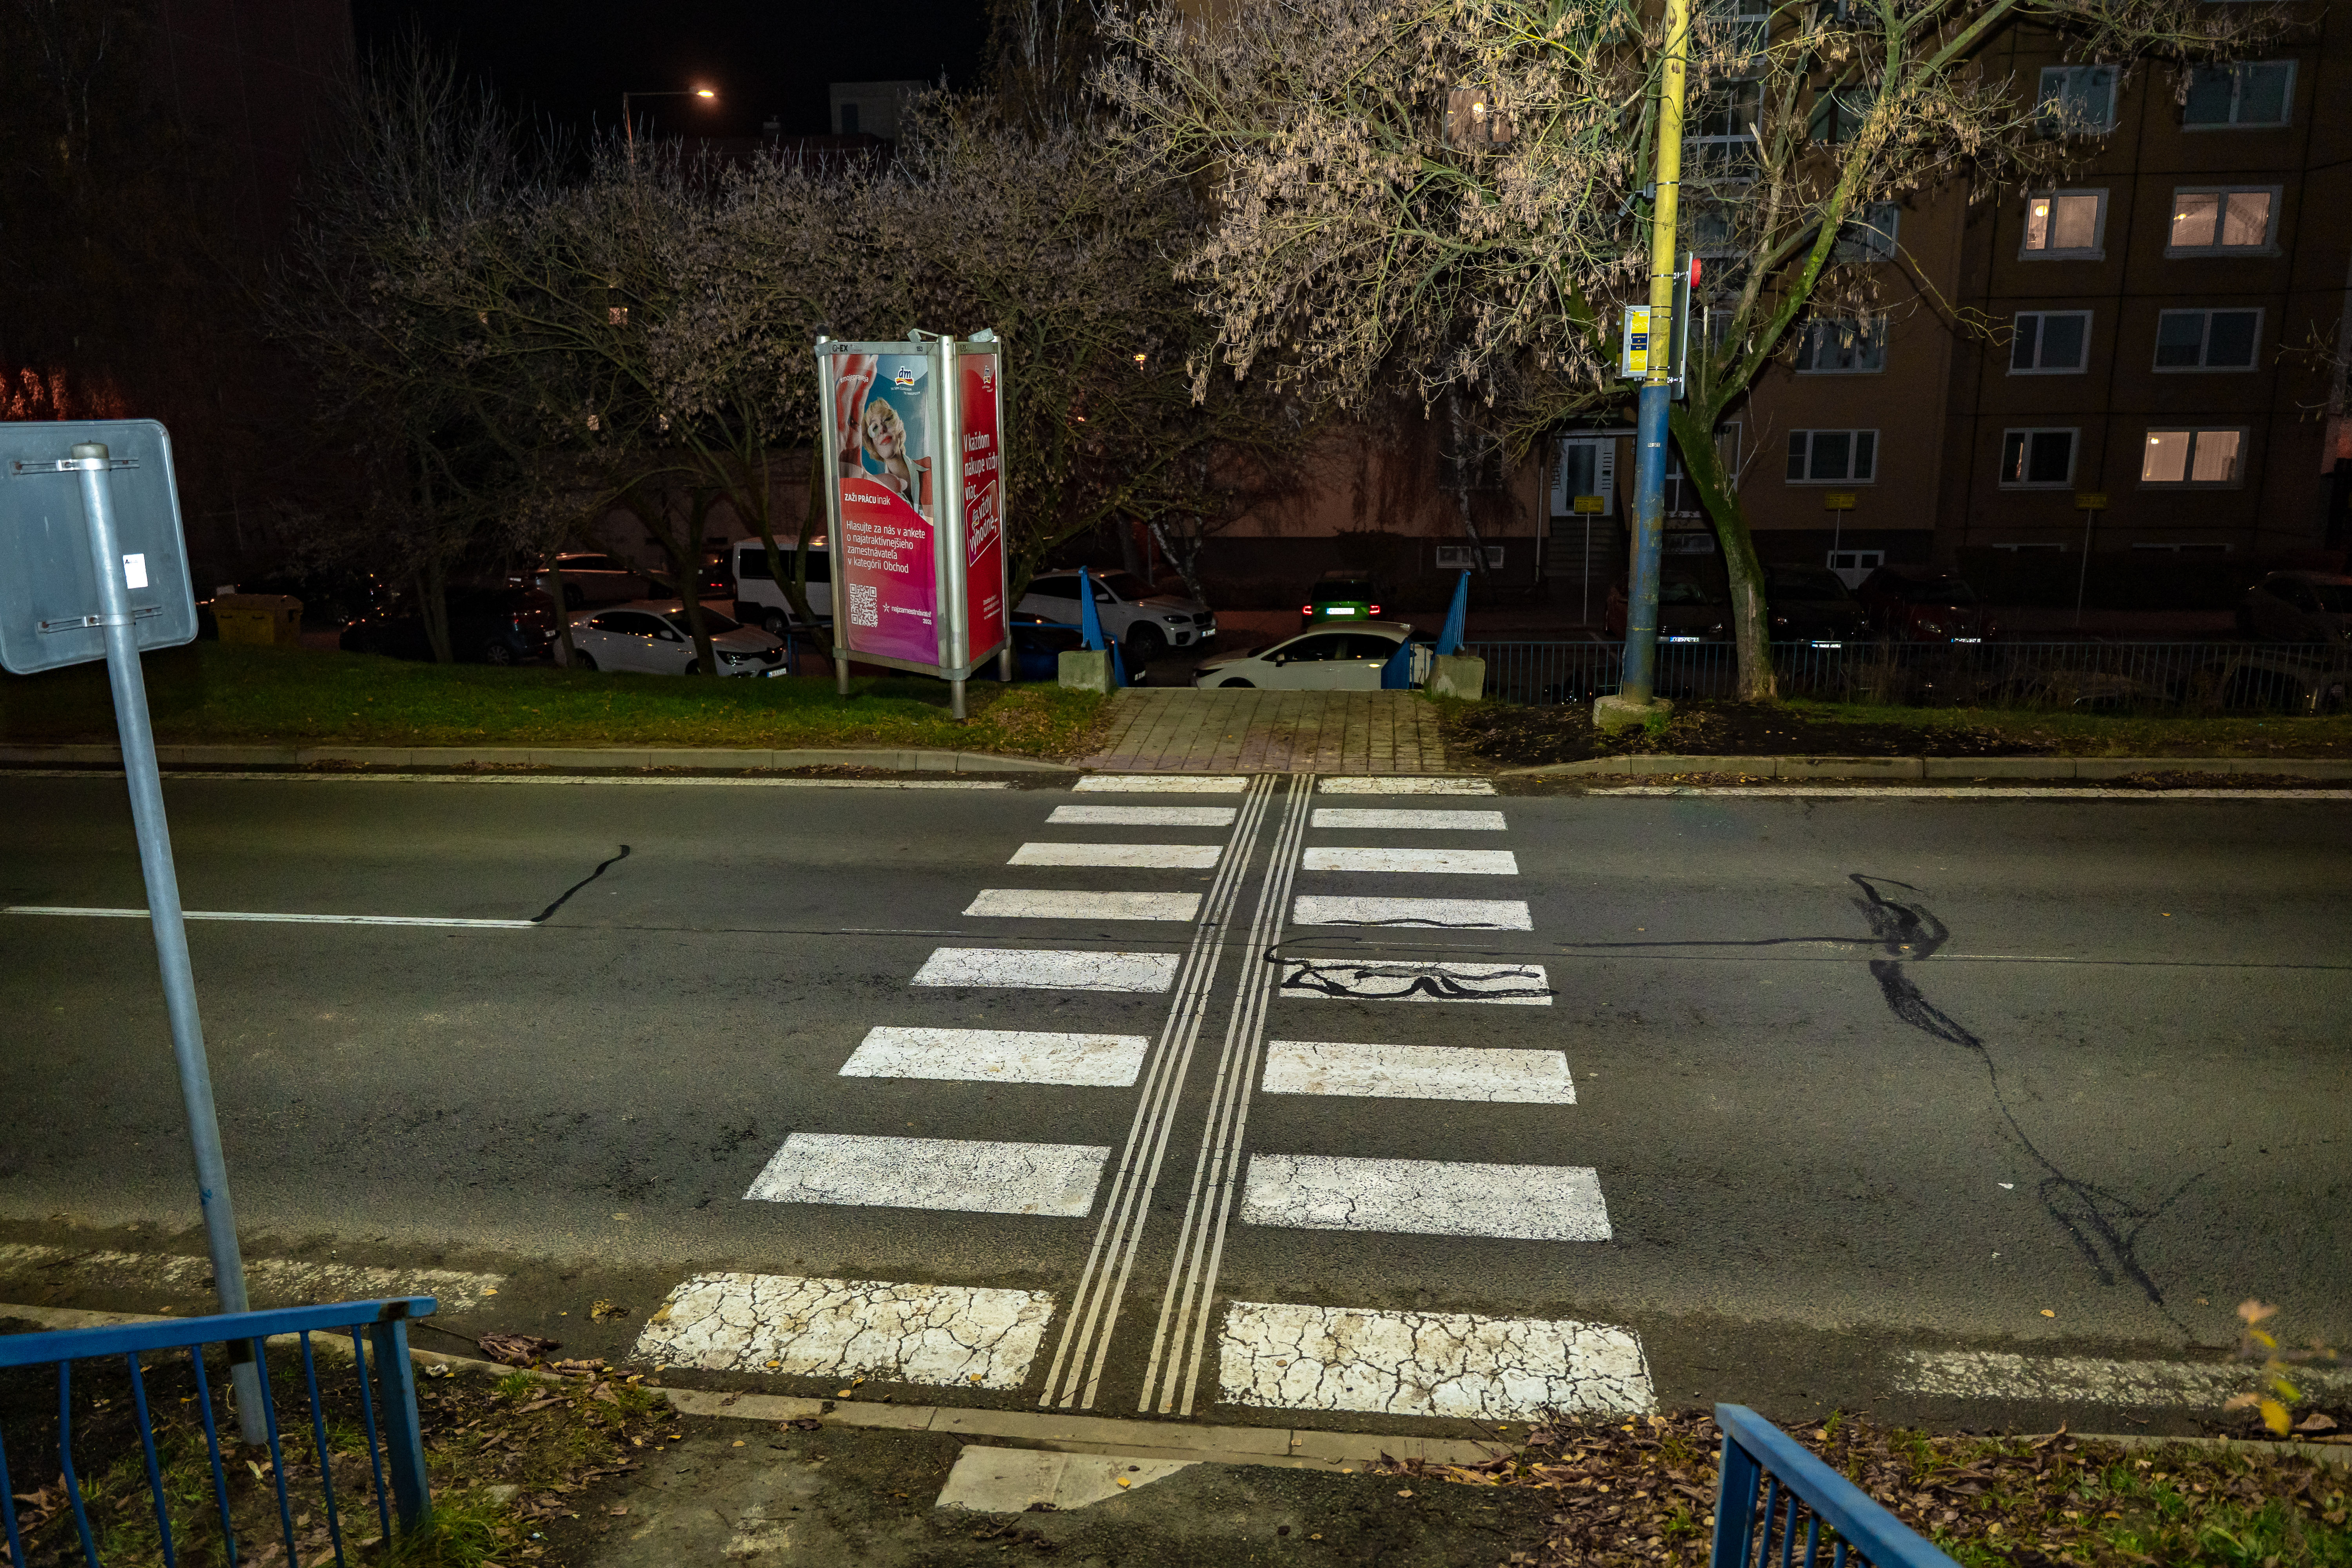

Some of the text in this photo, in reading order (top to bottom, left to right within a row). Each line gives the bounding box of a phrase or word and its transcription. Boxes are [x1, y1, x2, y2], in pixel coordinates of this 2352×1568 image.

[899, 367, 911, 378] dm
[964, 431, 990, 452] V každom
[965, 452, 998, 477] nákupe vždy
[844, 492, 891, 505] ZAŽI PRÁCU inak
[965, 482, 978, 501] viac.
[979, 494, 992, 519] vždy
[847, 520, 872, 534] Hlasujte
[884, 524, 895, 535] nás
[903, 527, 925, 539] ankete
[853, 534, 913, 550] najatraktívnejšieho
[847, 546, 897, 560] zamestnávateľa
[854, 556, 881, 570] kategórii
[883, 561, 909, 573] Obchod
[891, 606, 931, 617] najzamestnávateľ
